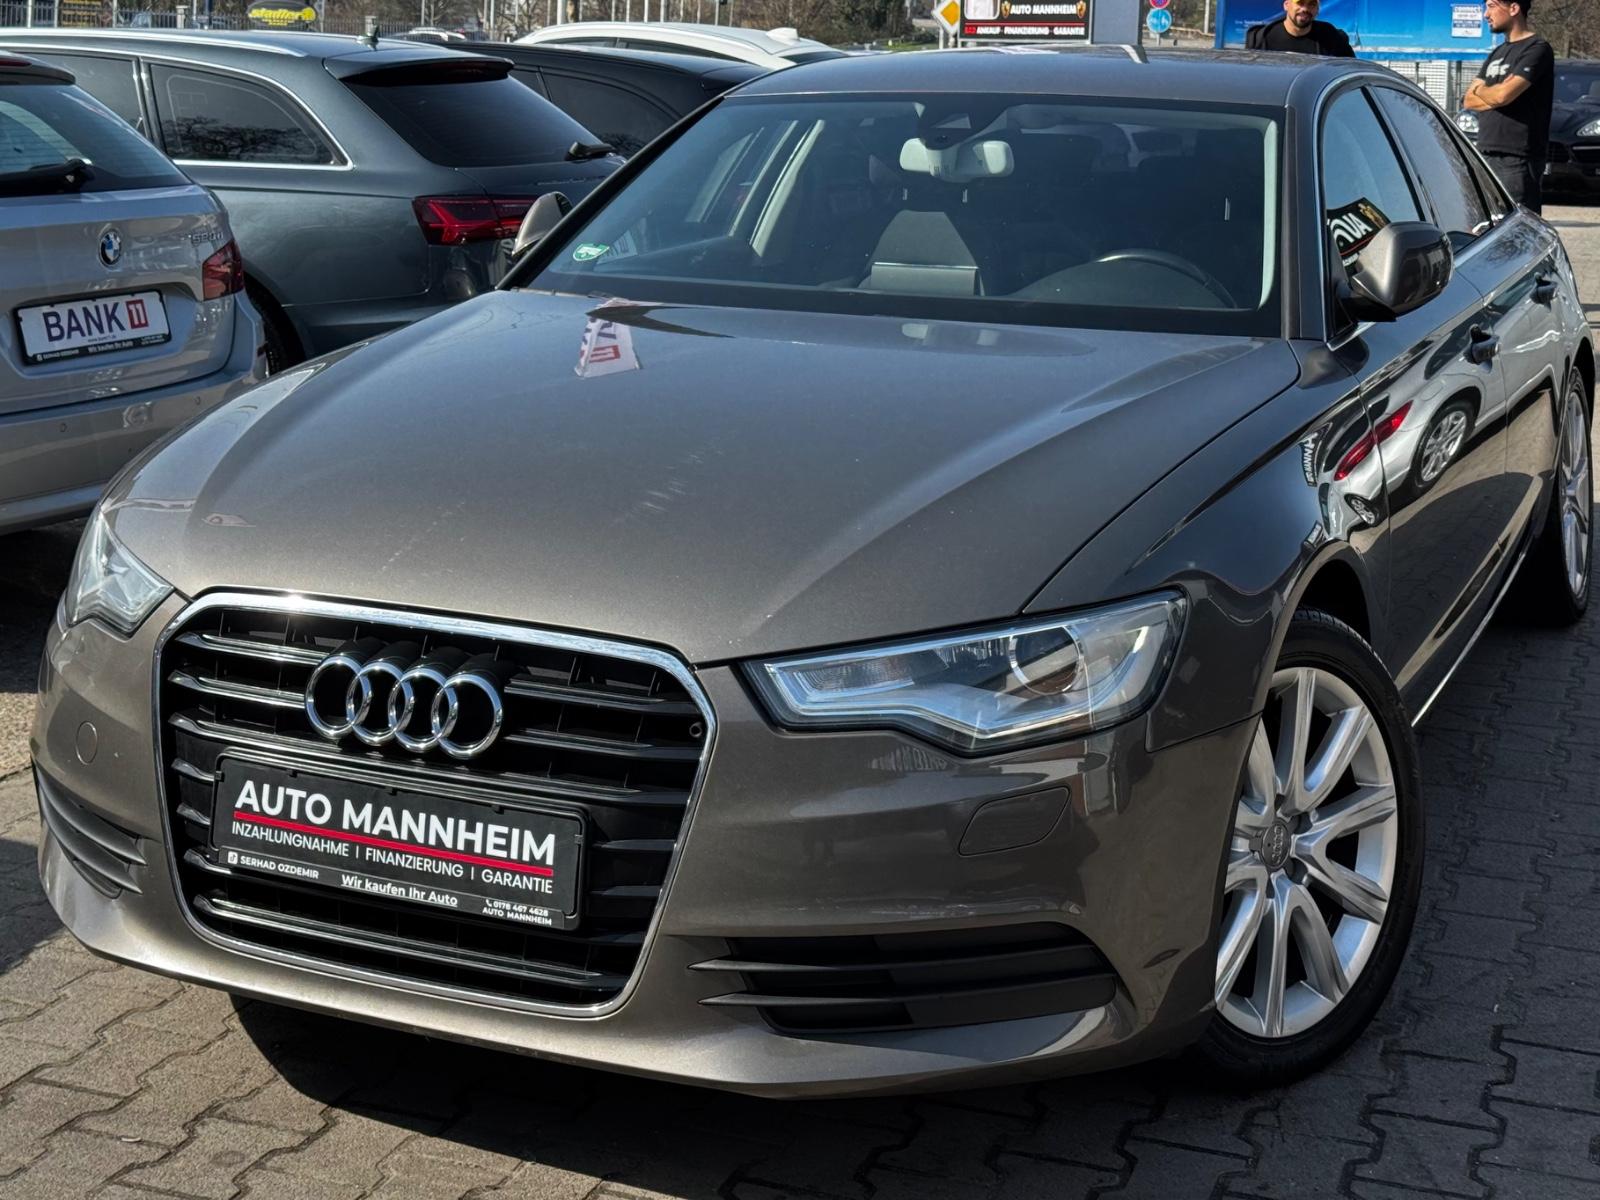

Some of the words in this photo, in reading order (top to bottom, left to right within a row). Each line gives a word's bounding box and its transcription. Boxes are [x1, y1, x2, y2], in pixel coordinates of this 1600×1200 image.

[1010, 4, 1032, 15] AUTO
[1032, 4, 1077, 15] MANNHEIM
[42, 301, 126, 342] BANK
[128, 301, 147, 328] 11
[234, 779, 333, 825] AUTO
[341, 798, 556, 866] MANNHEIM
[231, 820, 350, 858] INZAHLUNGNAHME
[365, 847, 464, 878] FINANZIERUNG
[481, 869, 554, 895] GARANTIE
[240, 855, 276, 870] SERHAD
[277, 863, 320, 879] OZDEMIR
[341, 874, 363, 888] Wir
[364, 878, 406, 898] kaufen
[408, 886, 426, 900] Ihr
[427, 891, 459, 906] Auto
[482, 906, 505, 917] AUTO
[506, 911, 553, 926] MANNHEIM
[493, 900, 511, 910] 0178
